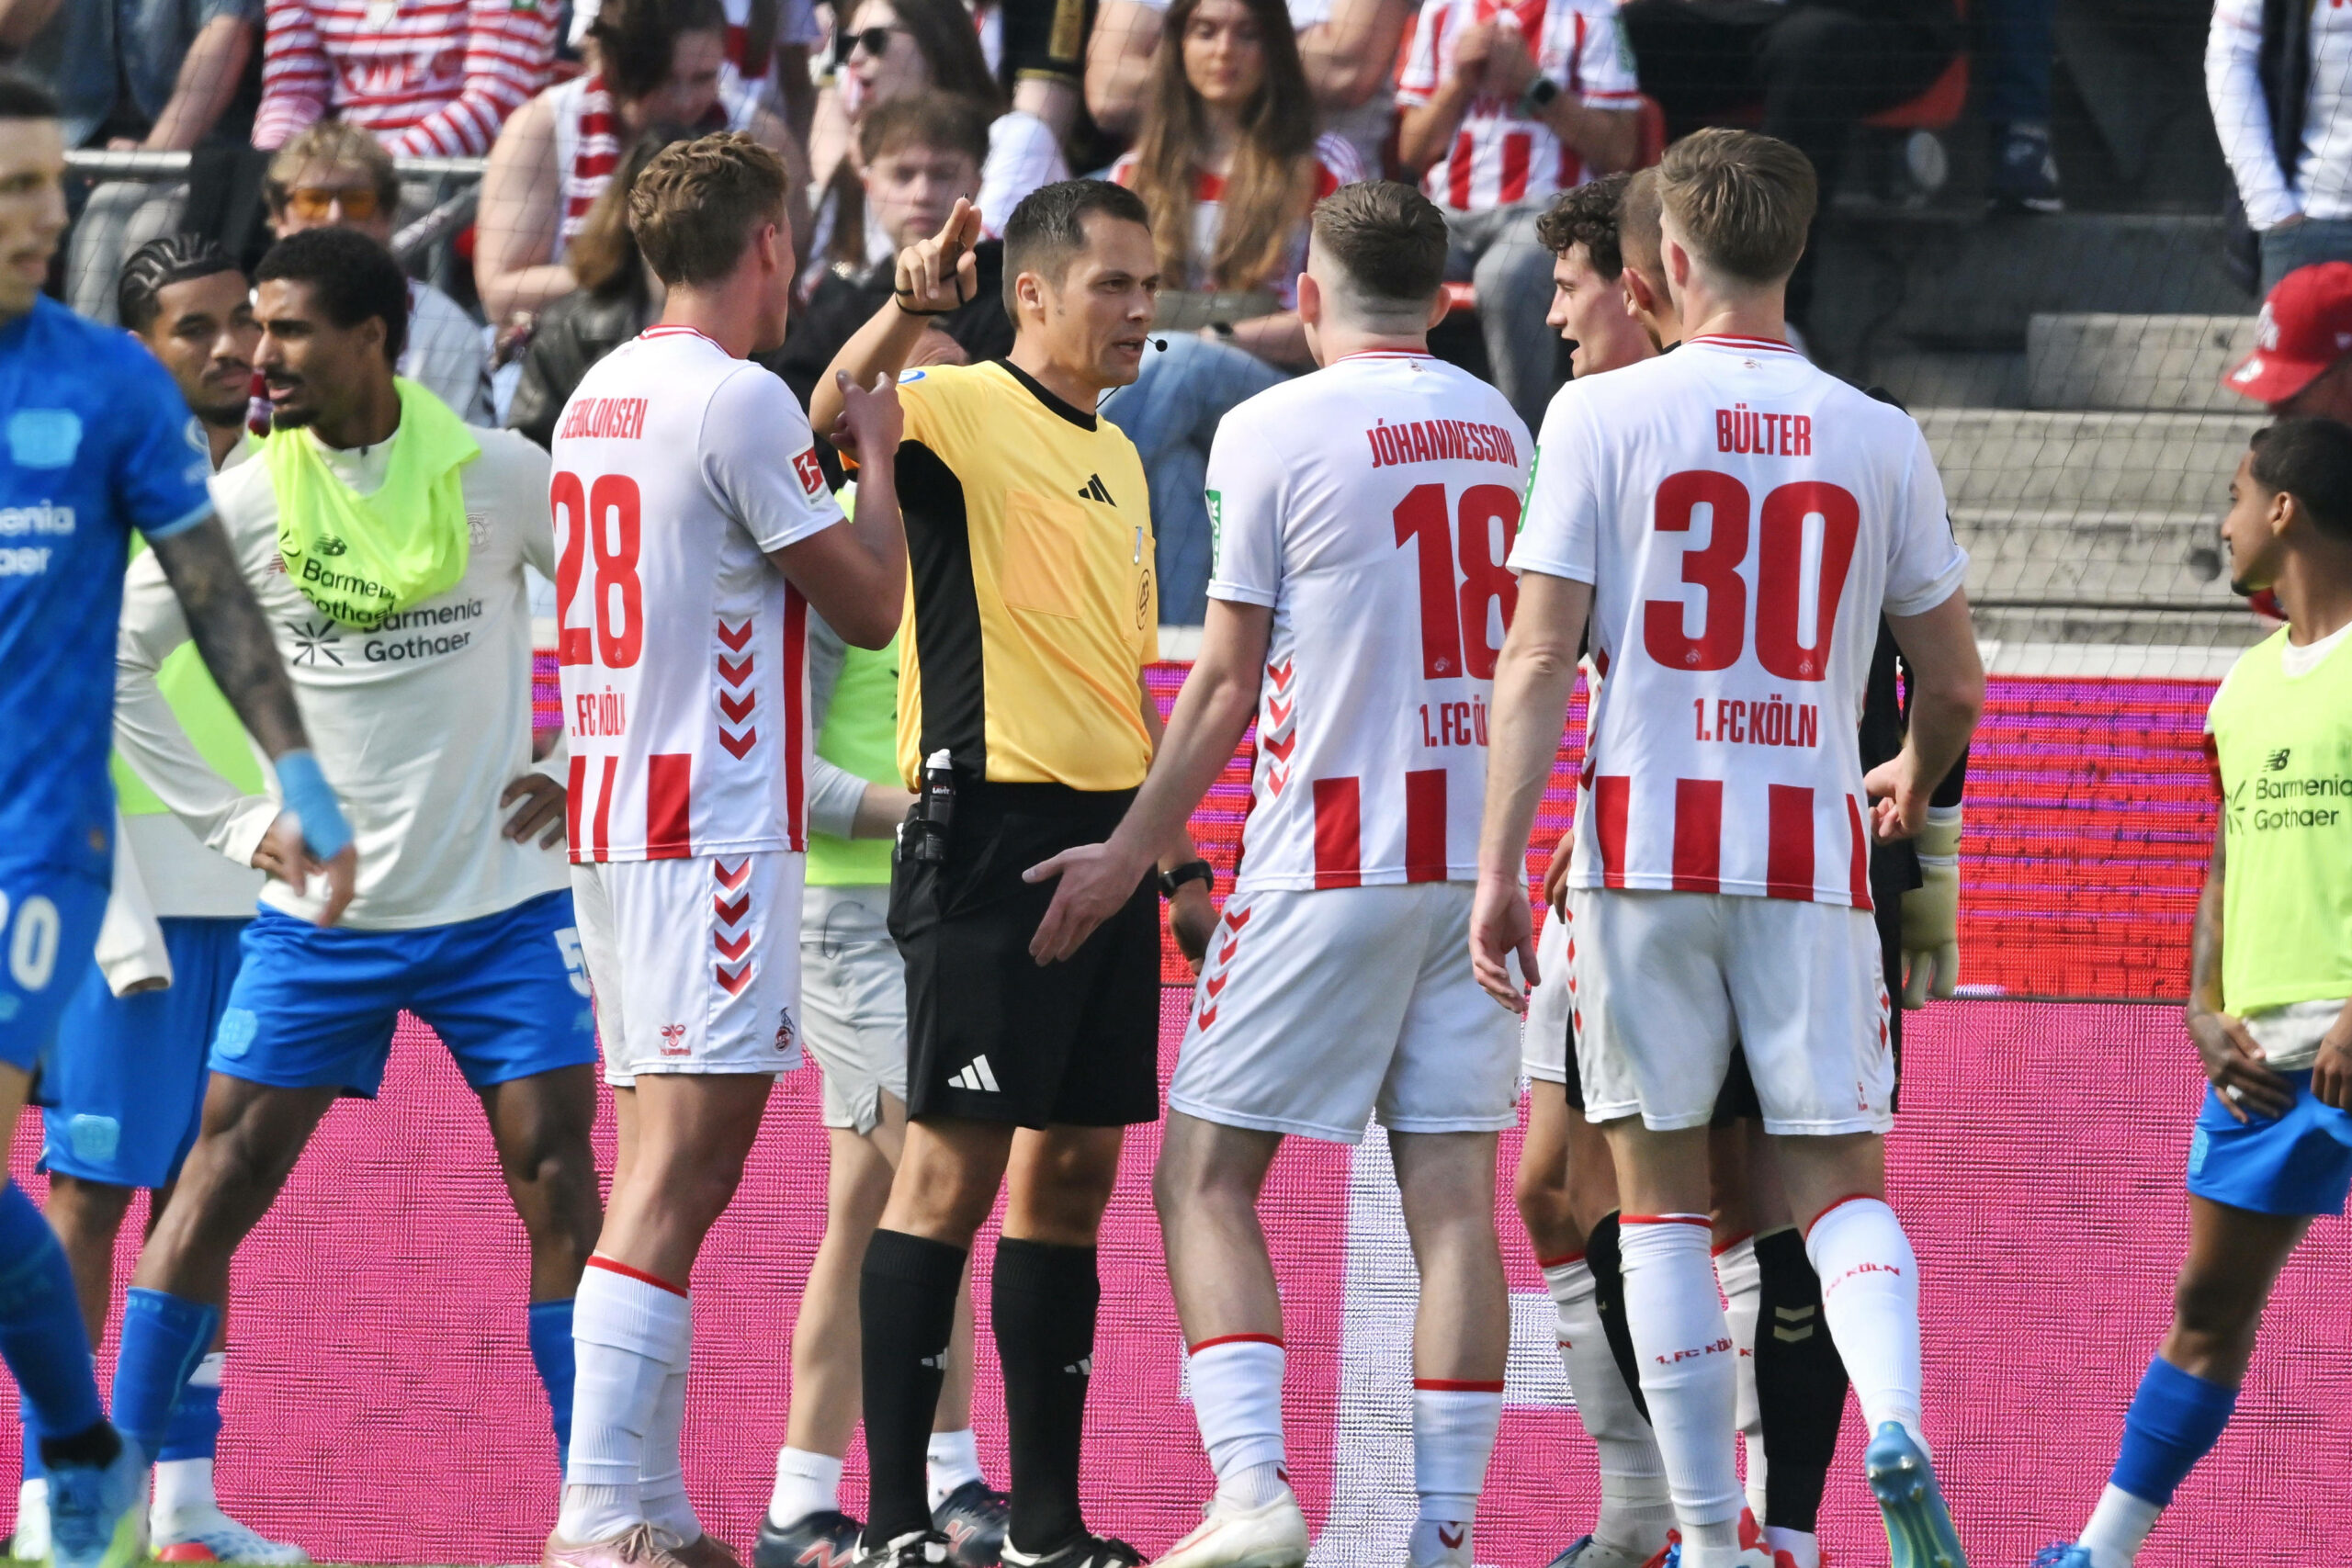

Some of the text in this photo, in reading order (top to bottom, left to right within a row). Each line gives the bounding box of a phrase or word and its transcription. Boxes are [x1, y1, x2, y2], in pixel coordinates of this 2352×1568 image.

[1366, 418, 1518, 468] JÓHANNESSON
[1715, 402, 1812, 457] BÜLTER
[0, 498, 76, 536] enia
[302, 557, 397, 600] Barmen
[550, 470, 643, 669] 28
[1393, 483, 1522, 681] 18
[1644, 469, 1860, 682] 30
[365, 631, 471, 662] Gothaer
[2256, 773, 2352, 800] Barmenia
[2254, 807, 2340, 831] Gothaer
[0, 888, 61, 992] 0
[1705, 1337, 1734, 1355] KÖL
